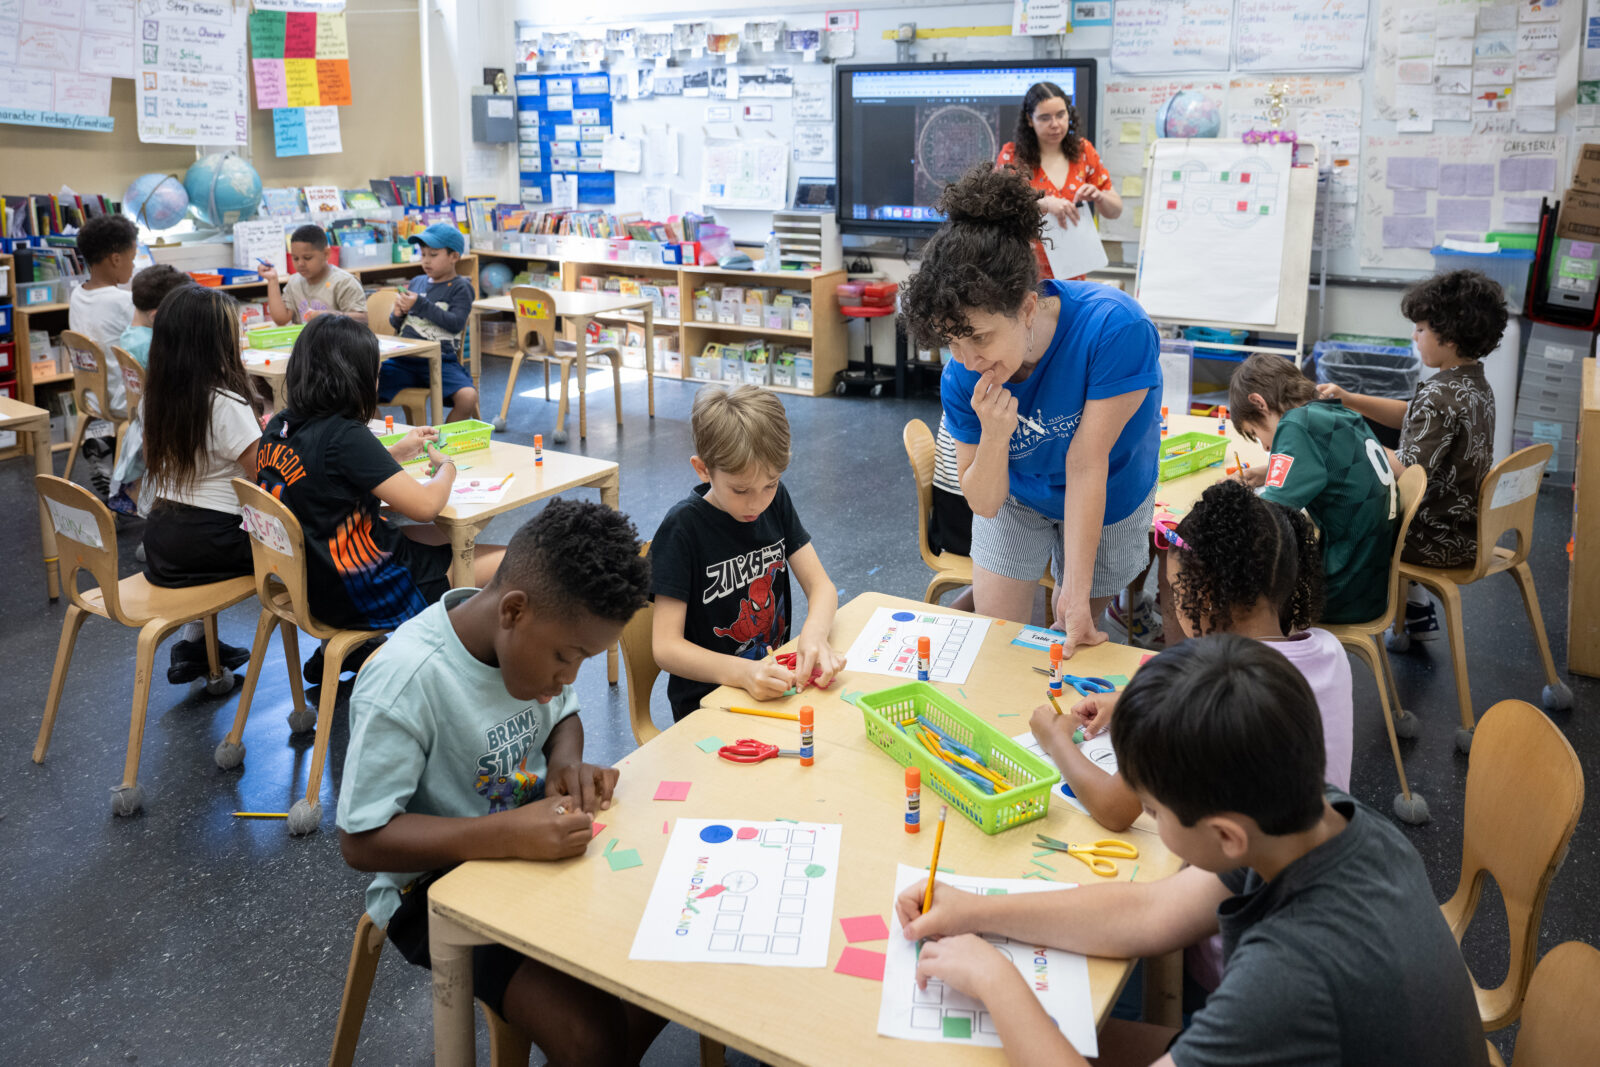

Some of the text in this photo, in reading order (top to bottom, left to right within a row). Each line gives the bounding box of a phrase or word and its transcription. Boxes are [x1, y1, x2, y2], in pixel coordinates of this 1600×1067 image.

[166, 1, 189, 16] Story
[1020, 24, 1028, 33] K
[1110, 106, 1146, 116] HALLWAY
[234, 110, 247, 142] PLOT
[1503, 140, 1556, 153] CAFETERIA
[1009, 415, 1081, 452] HATTAN SCHO
[256, 443, 306, 487] RUNSON
[1031, 634, 1050, 642] Table
[1033, 944, 1049, 992] MANDA
